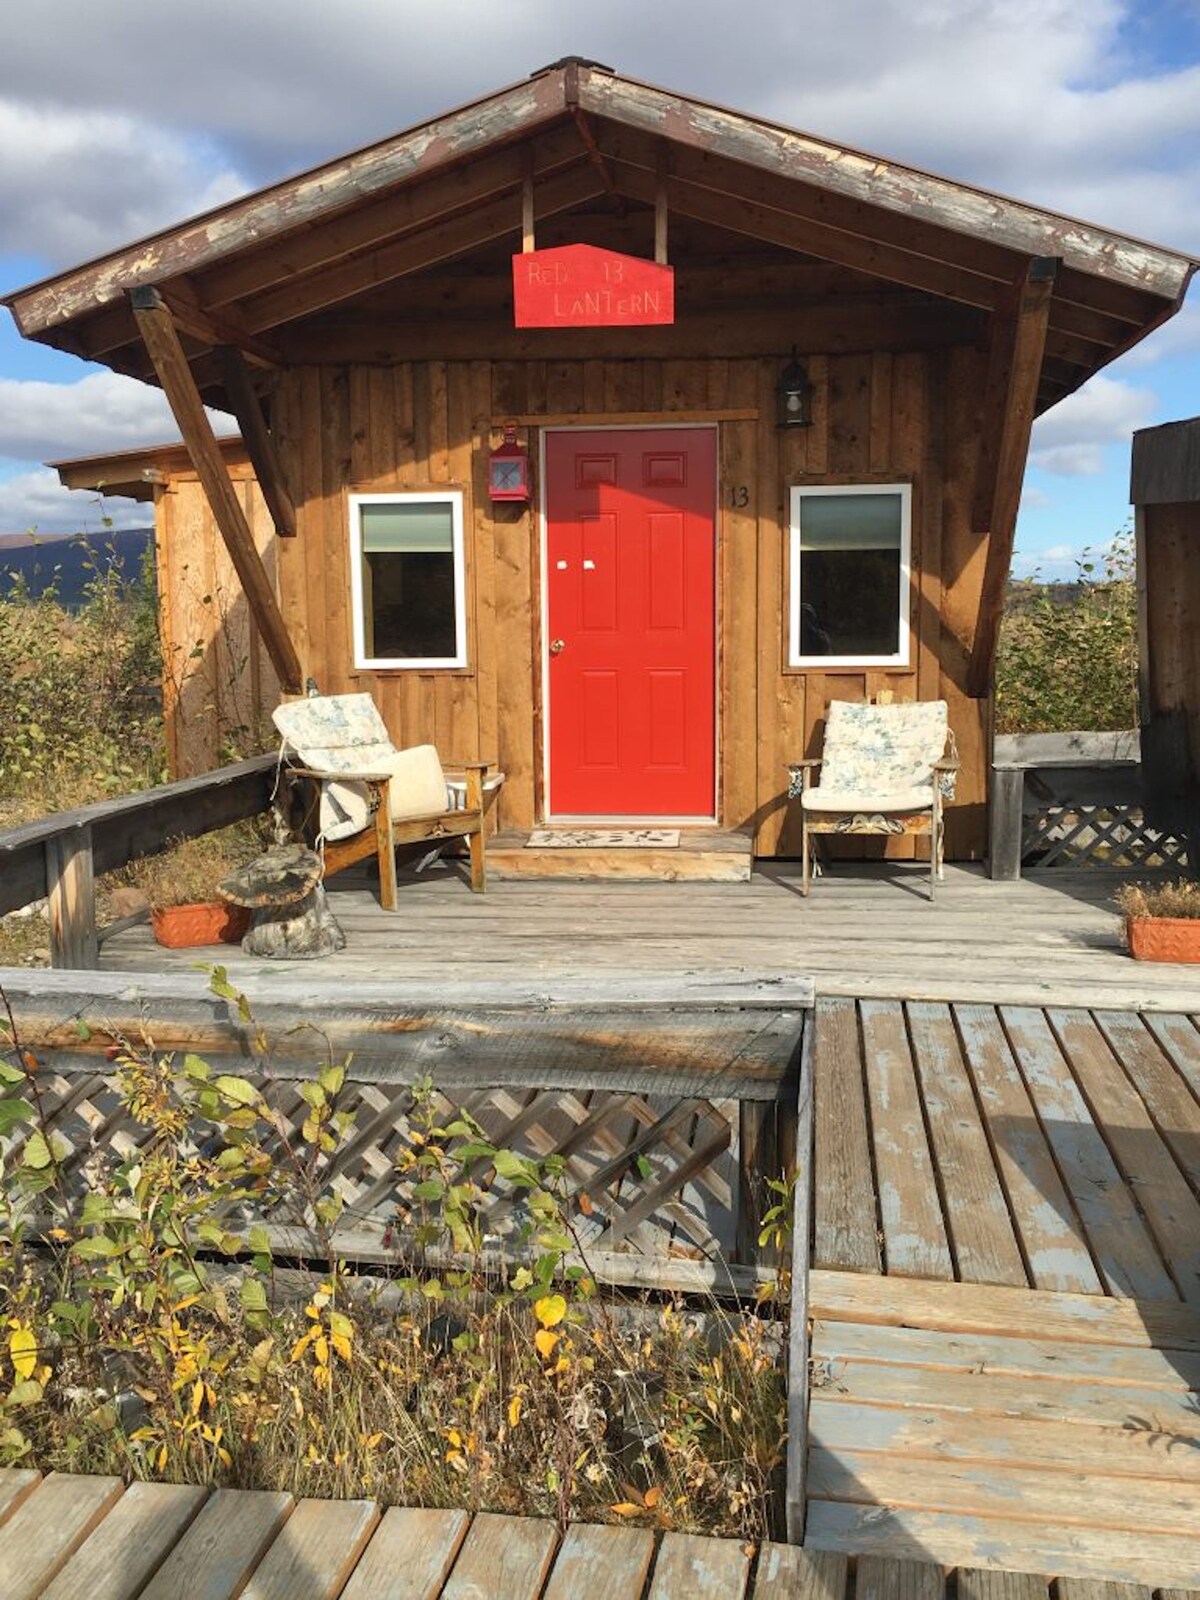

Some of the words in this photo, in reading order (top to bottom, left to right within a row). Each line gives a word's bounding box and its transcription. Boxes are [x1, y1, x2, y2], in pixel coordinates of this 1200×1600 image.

[603, 261, 624, 284] 13
[553, 290, 660, 317] LANTERN
[731, 486, 749, 508] 13
